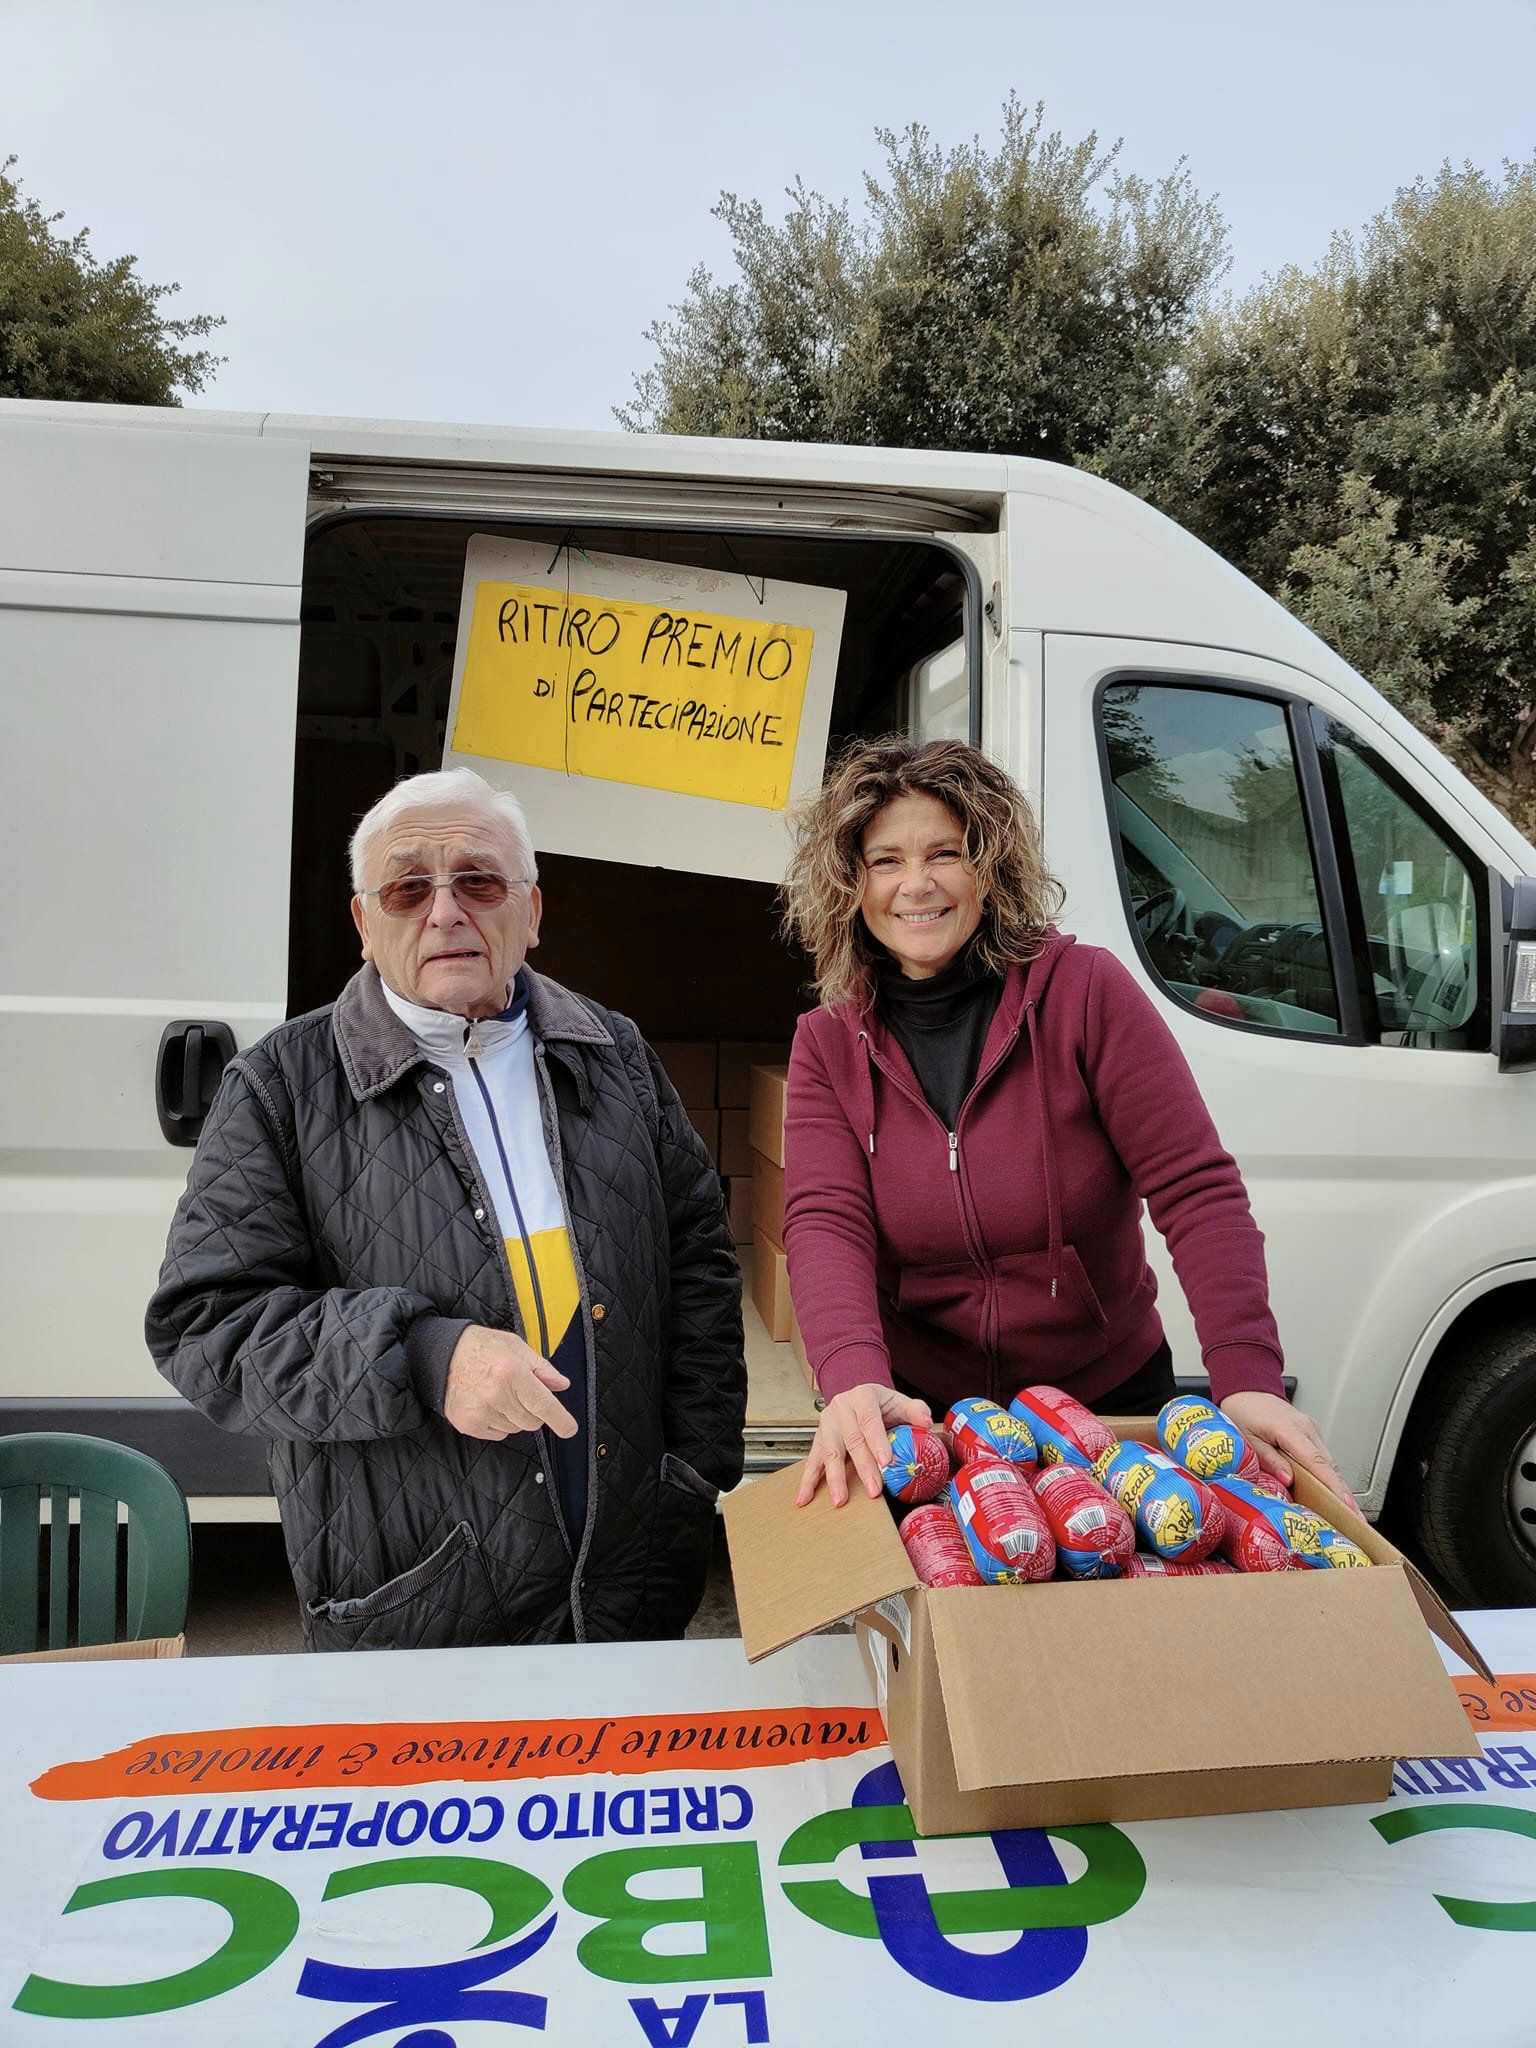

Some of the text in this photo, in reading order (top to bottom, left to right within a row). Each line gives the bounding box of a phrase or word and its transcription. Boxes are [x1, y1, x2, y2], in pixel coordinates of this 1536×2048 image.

[499, 598, 792, 680] RITIRO PREMIO
[125, 1720, 871, 1784] ravennate forlivese & imolese
[102, 1784, 754, 1860] CREDITO COOPERATIVO
[12, 1840, 773, 2019] BCC
[627, 1990, 771, 2048] LA
